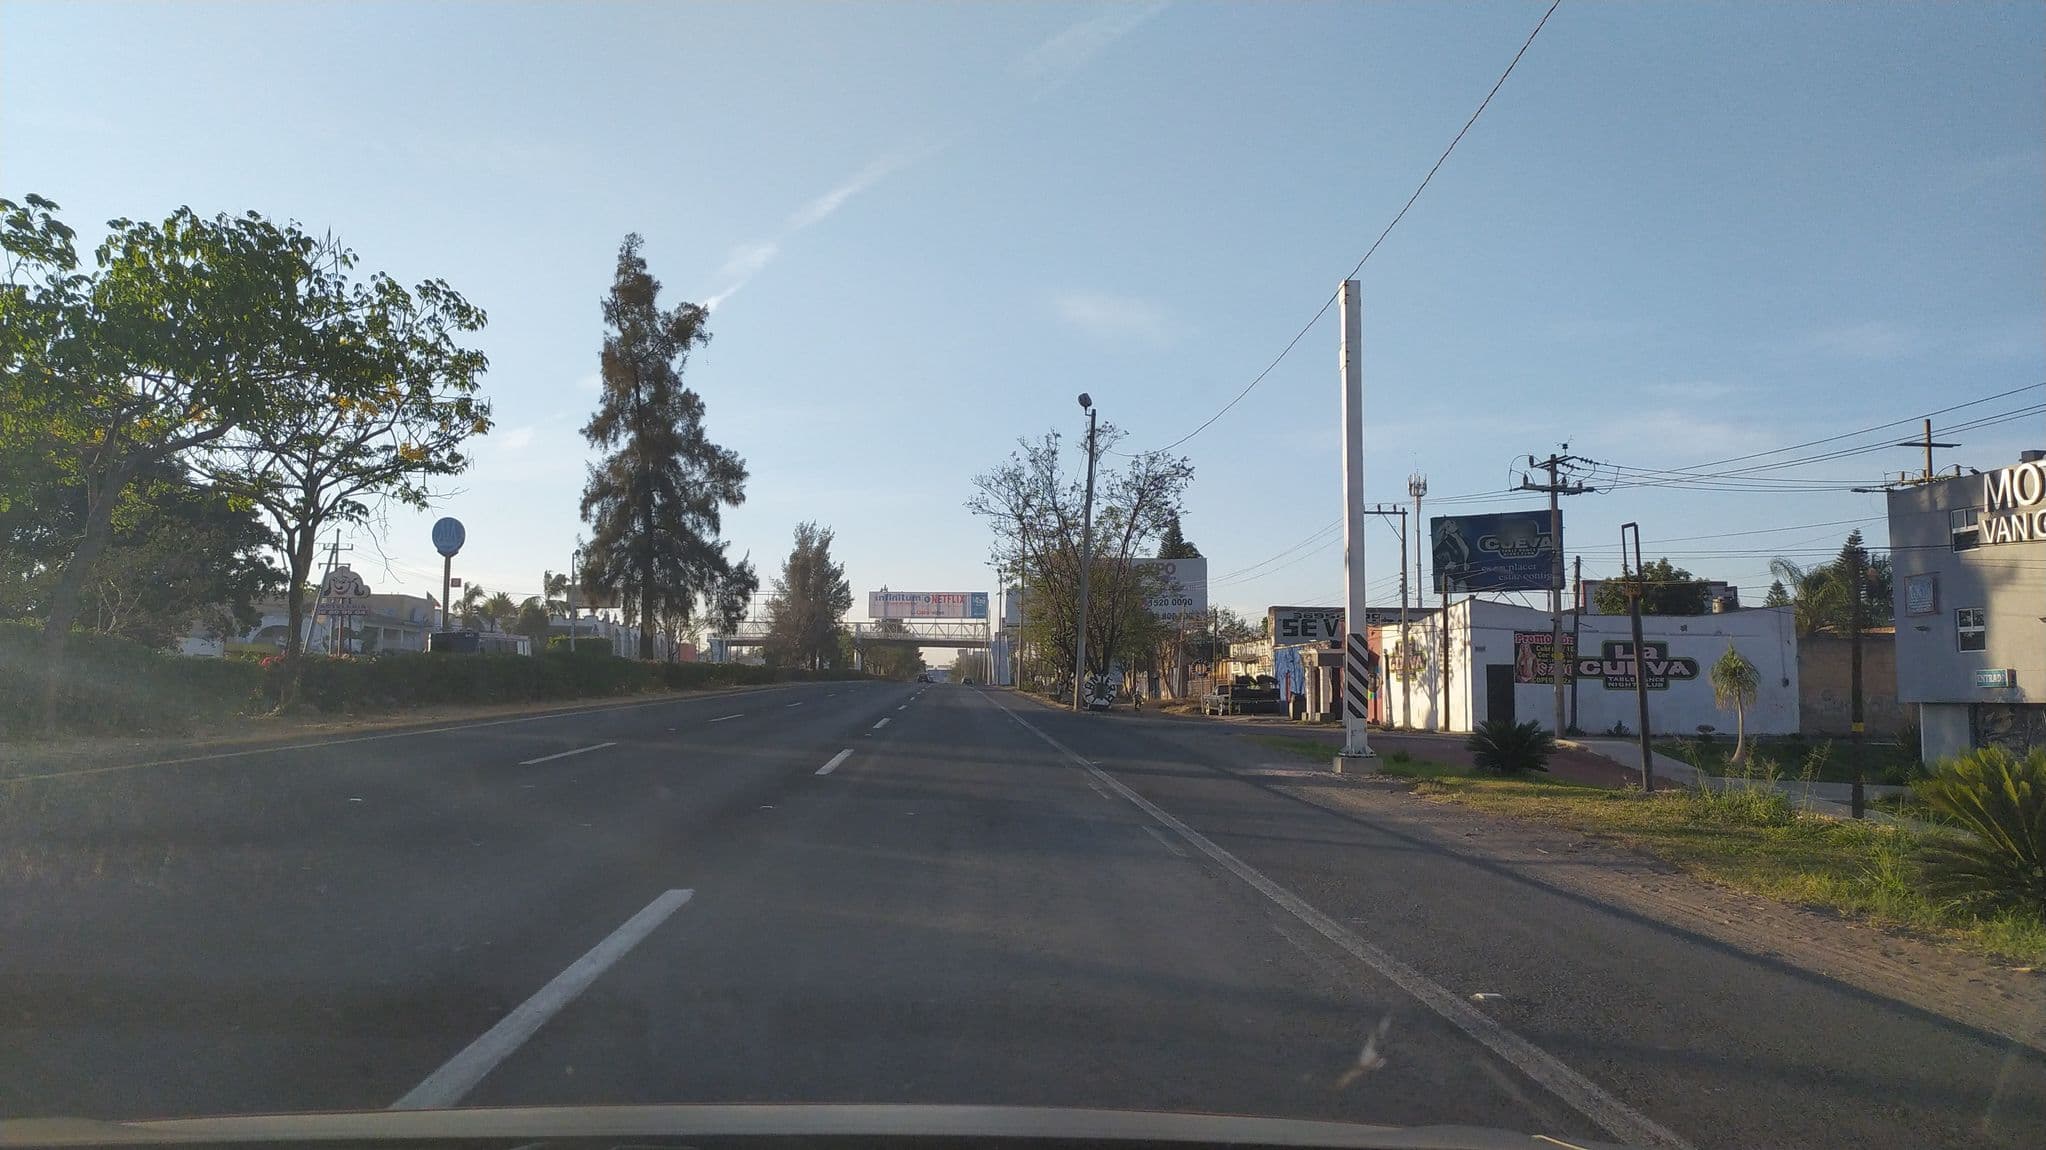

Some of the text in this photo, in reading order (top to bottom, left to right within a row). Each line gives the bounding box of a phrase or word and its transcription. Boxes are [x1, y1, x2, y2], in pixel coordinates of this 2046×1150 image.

[1982, 513, 2029, 543] VAN
[1523, 569, 1553, 581] contig
[931, 594, 966, 604] NETFLIX
[1282, 618, 1318, 637] SE
[1614, 645, 1660, 660] La
